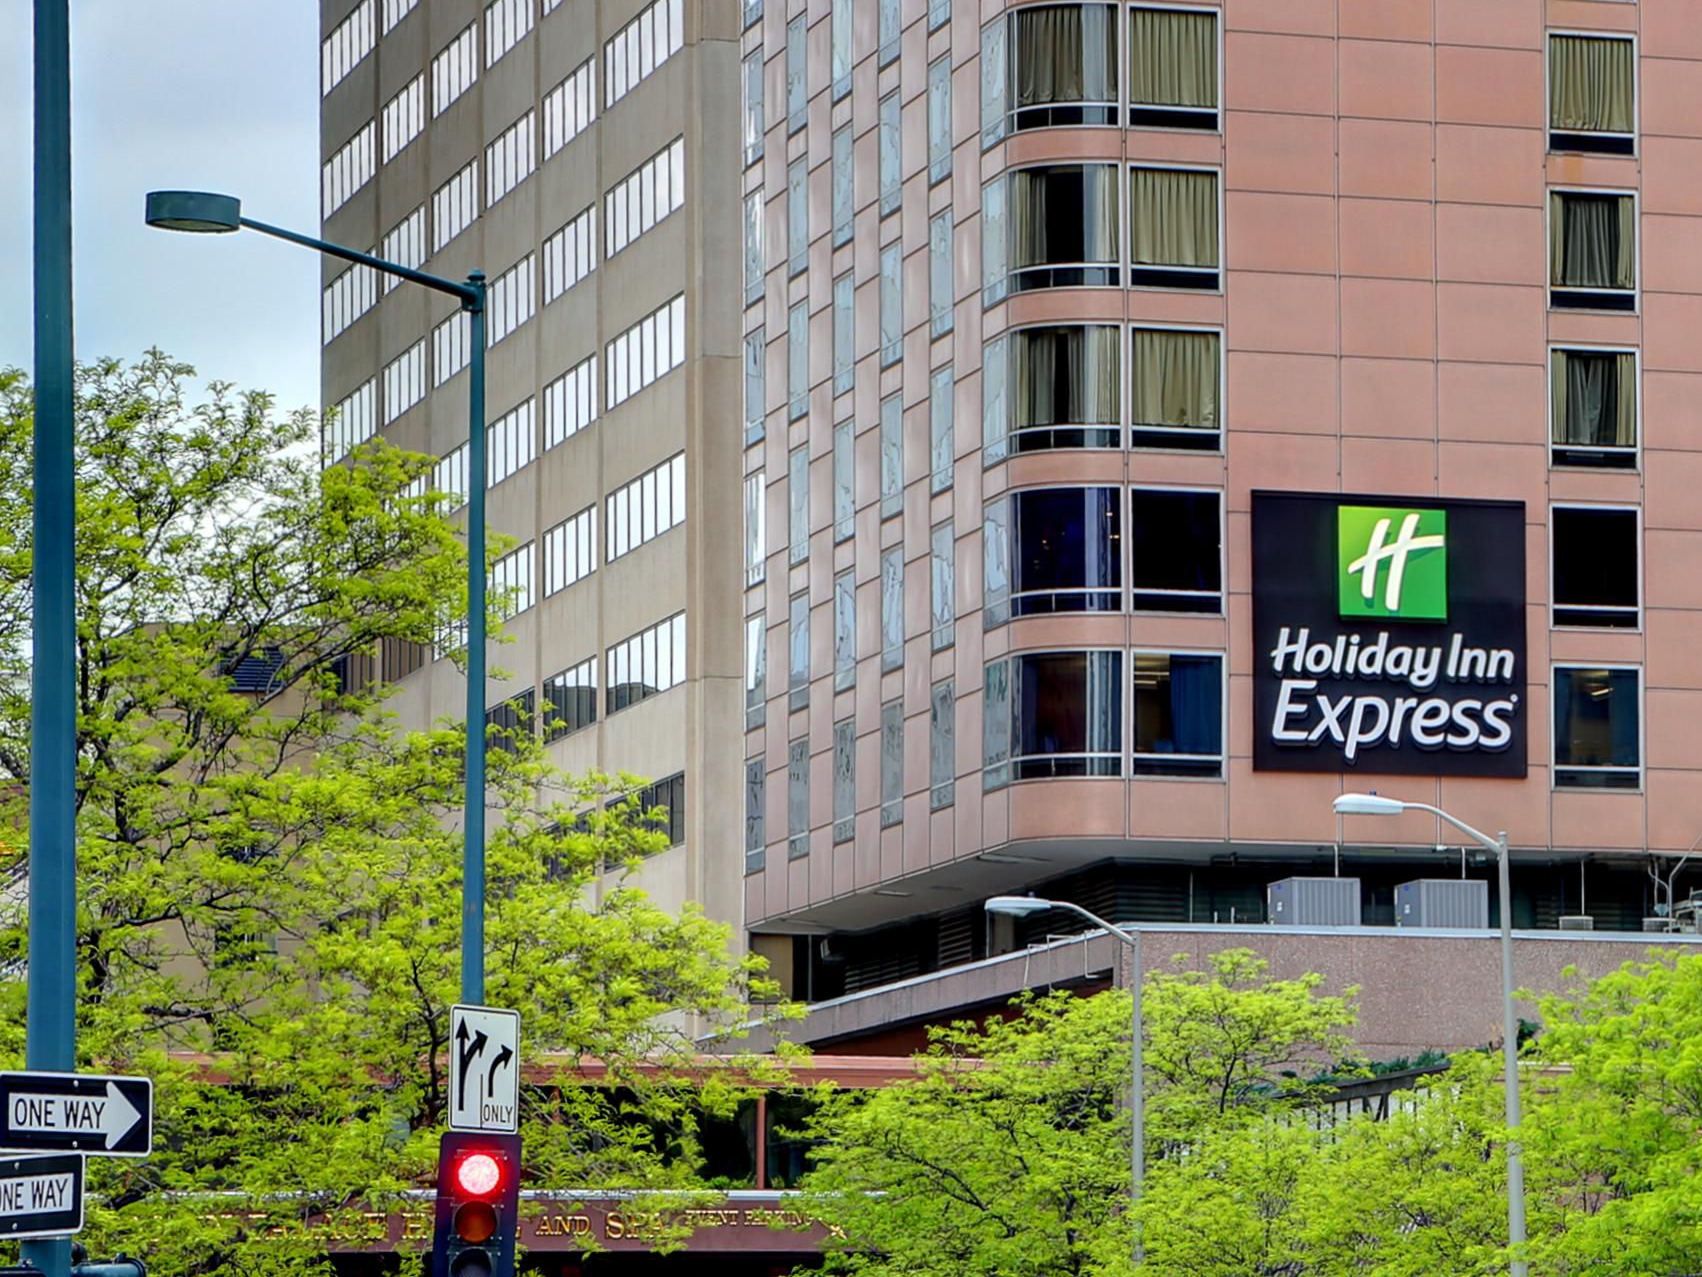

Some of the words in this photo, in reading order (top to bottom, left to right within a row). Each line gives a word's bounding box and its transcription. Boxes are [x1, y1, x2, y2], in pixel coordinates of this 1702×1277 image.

[1270, 627, 1442, 688] Holiday
[1447, 633, 1515, 679] Inn
[1271, 679, 1514, 760] Express
[14, 1098, 56, 1127] ONE
[64, 1100, 106, 1129] WAY
[483, 1104, 513, 1124] ONLY
[0, 1182, 24, 1212] NE
[31, 1178, 68, 1209] WAY
[535, 1215, 591, 1236] AND
